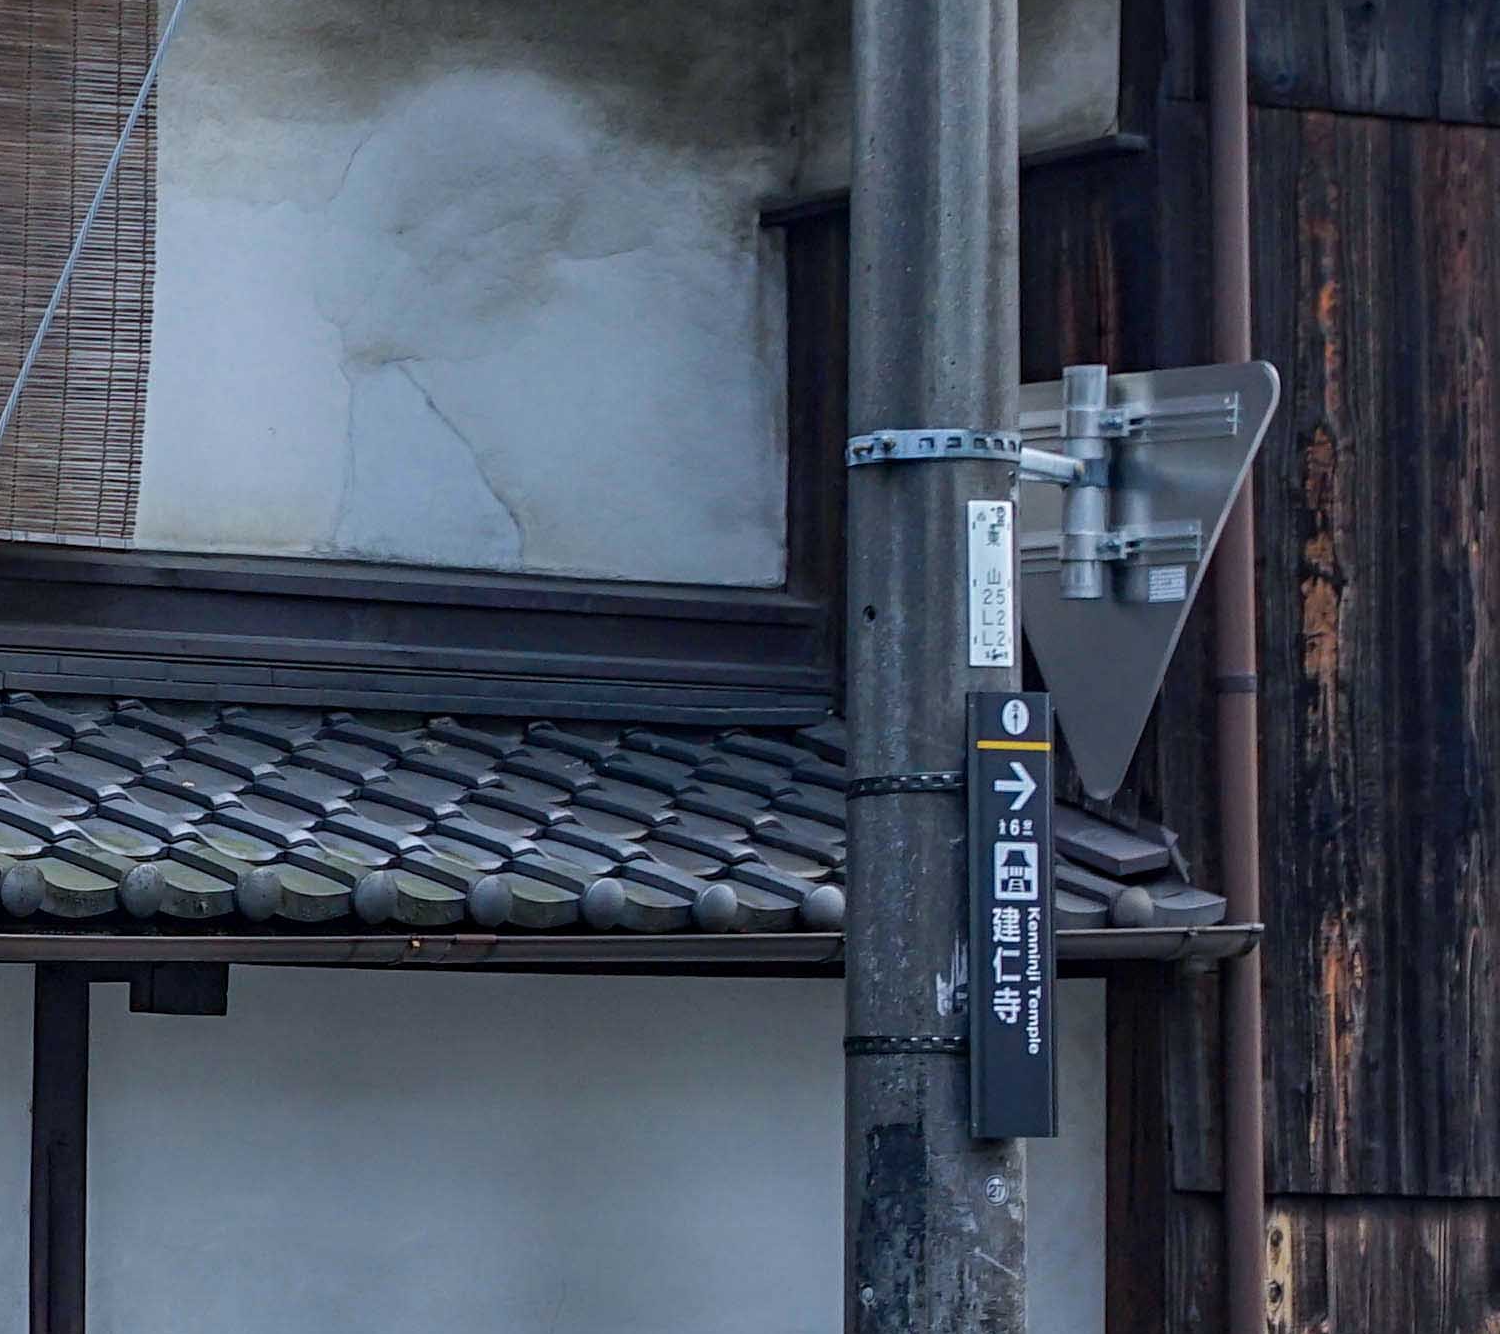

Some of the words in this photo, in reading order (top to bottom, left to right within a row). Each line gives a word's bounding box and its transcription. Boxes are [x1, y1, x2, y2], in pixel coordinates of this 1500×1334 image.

[982, 588, 1006, 605] 25
[992, 906, 1022, 1024] 建仁寺
[1026, 907, 1042, 982] Kenninji
[1026, 986, 1042, 1055] Temple
